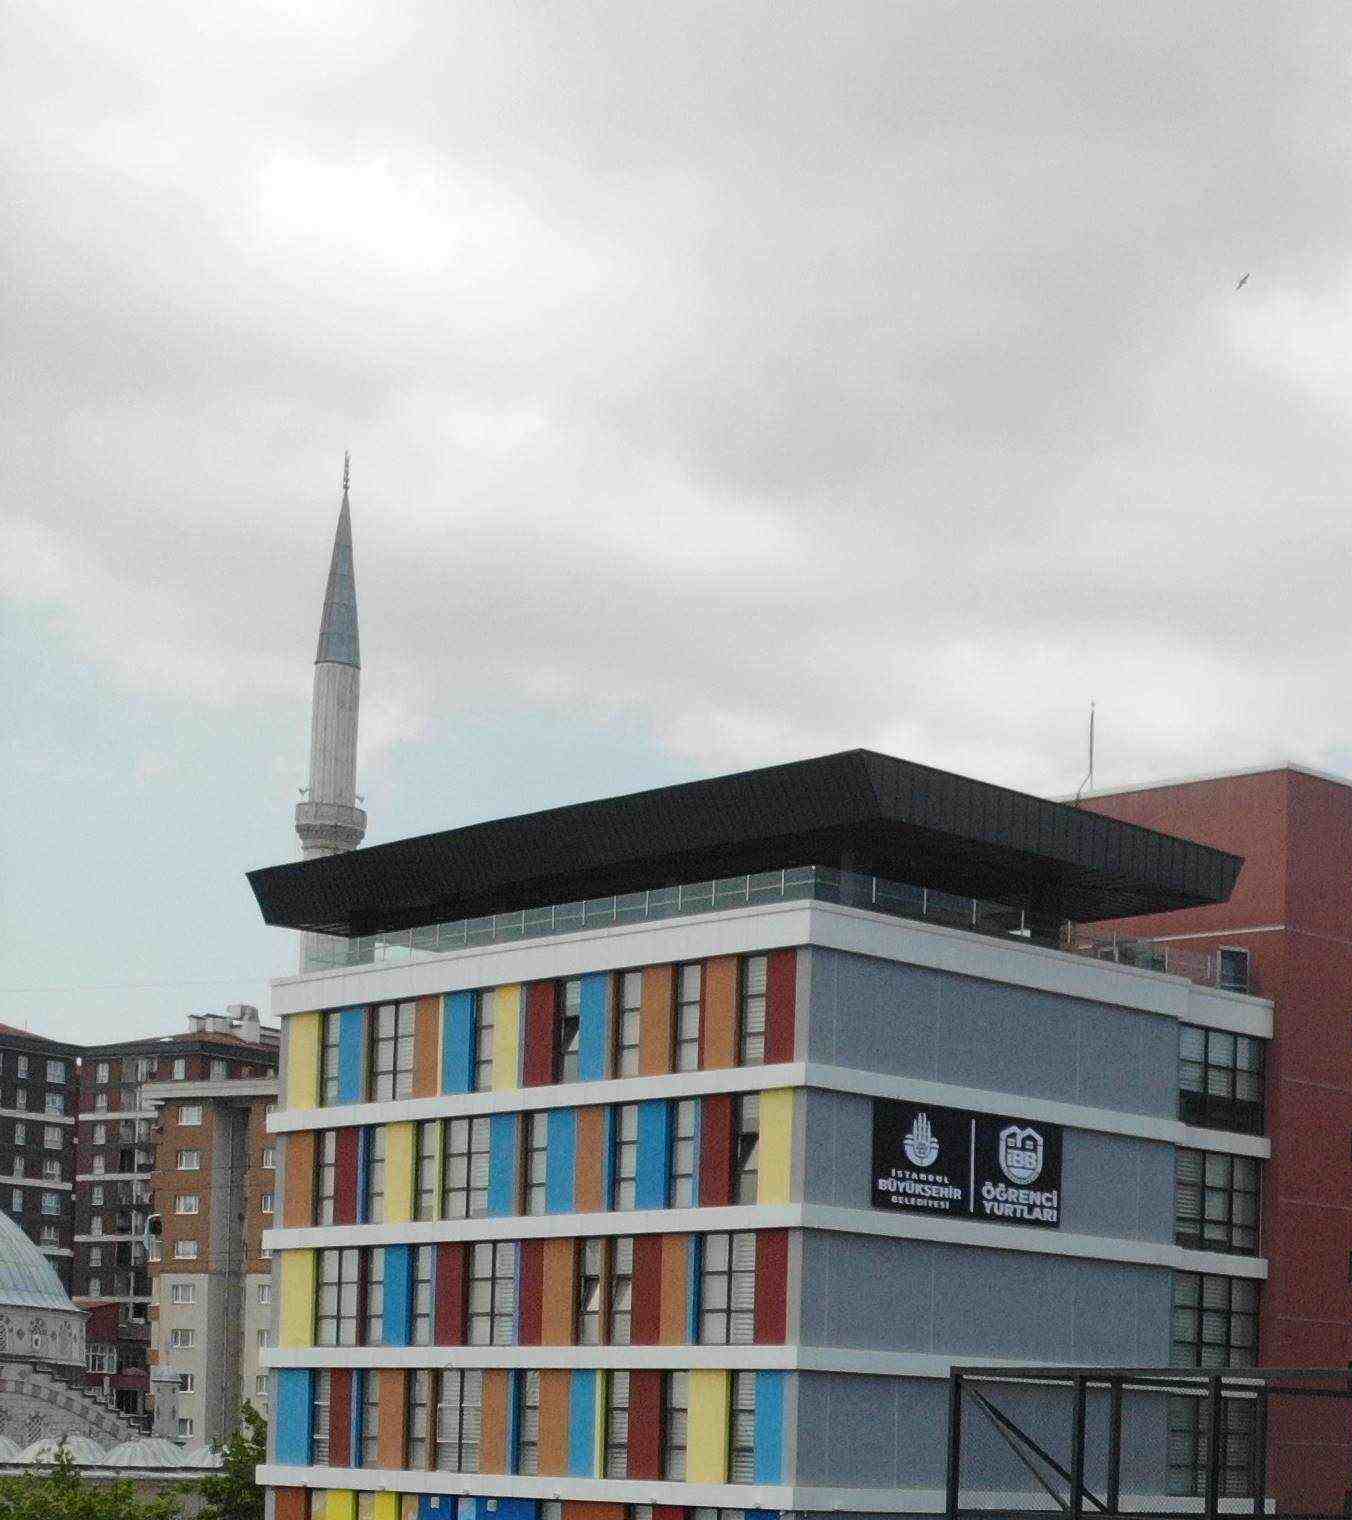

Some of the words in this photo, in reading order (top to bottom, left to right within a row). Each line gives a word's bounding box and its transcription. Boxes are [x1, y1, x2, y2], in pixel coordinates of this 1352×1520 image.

[891, 1167, 950, 1184] İSTANBUL
[891, 1195, 950, 1210] BELEDİYESİ
[981, 1181, 1058, 1208] ÖĞRENCİ
[982, 1200, 1057, 1222] YURTLARI
